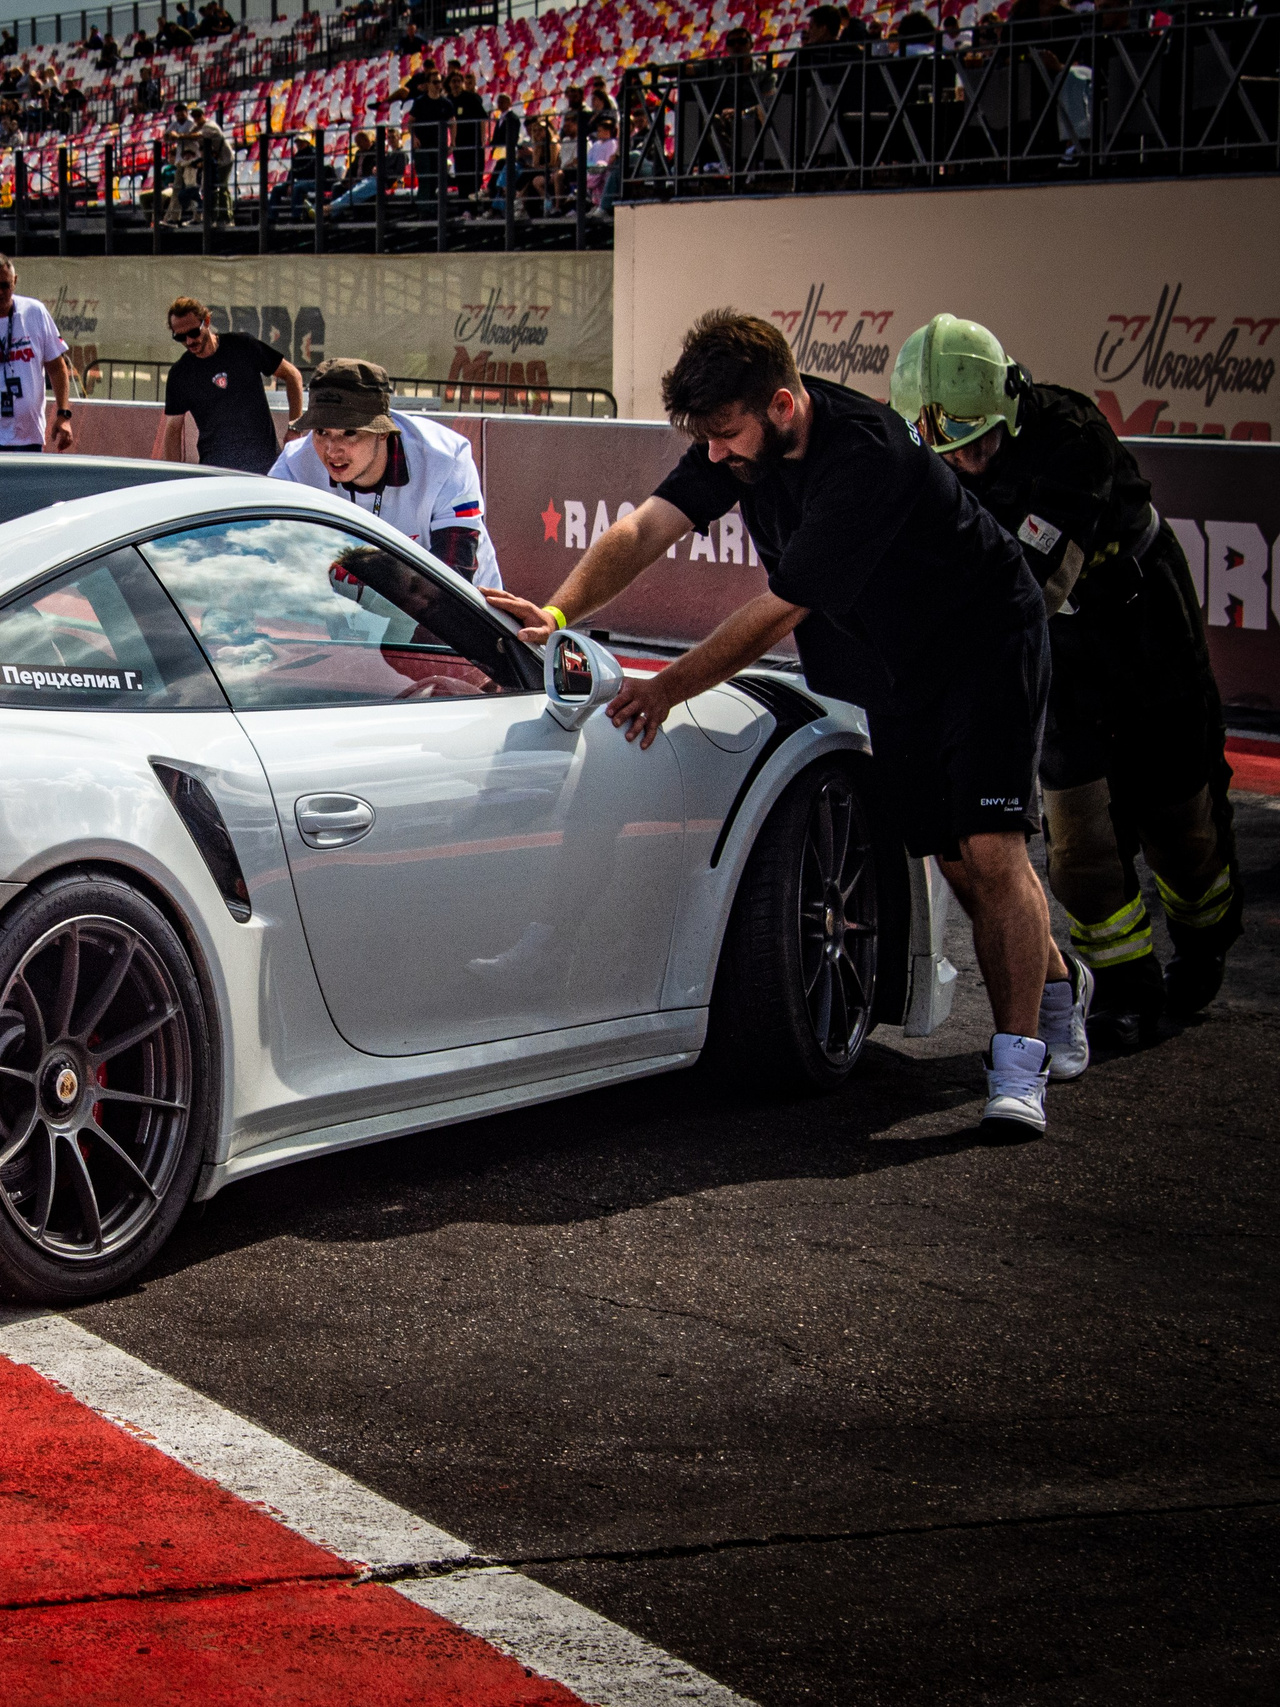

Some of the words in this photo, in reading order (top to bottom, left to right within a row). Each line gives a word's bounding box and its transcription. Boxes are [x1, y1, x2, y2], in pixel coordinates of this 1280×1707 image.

[1094, 282, 1276, 407] Московская
[2, 666, 120, 690] Перцхелия
[124, 672, 143, 691] Г.
[981, 798, 1005, 806] ENVY
